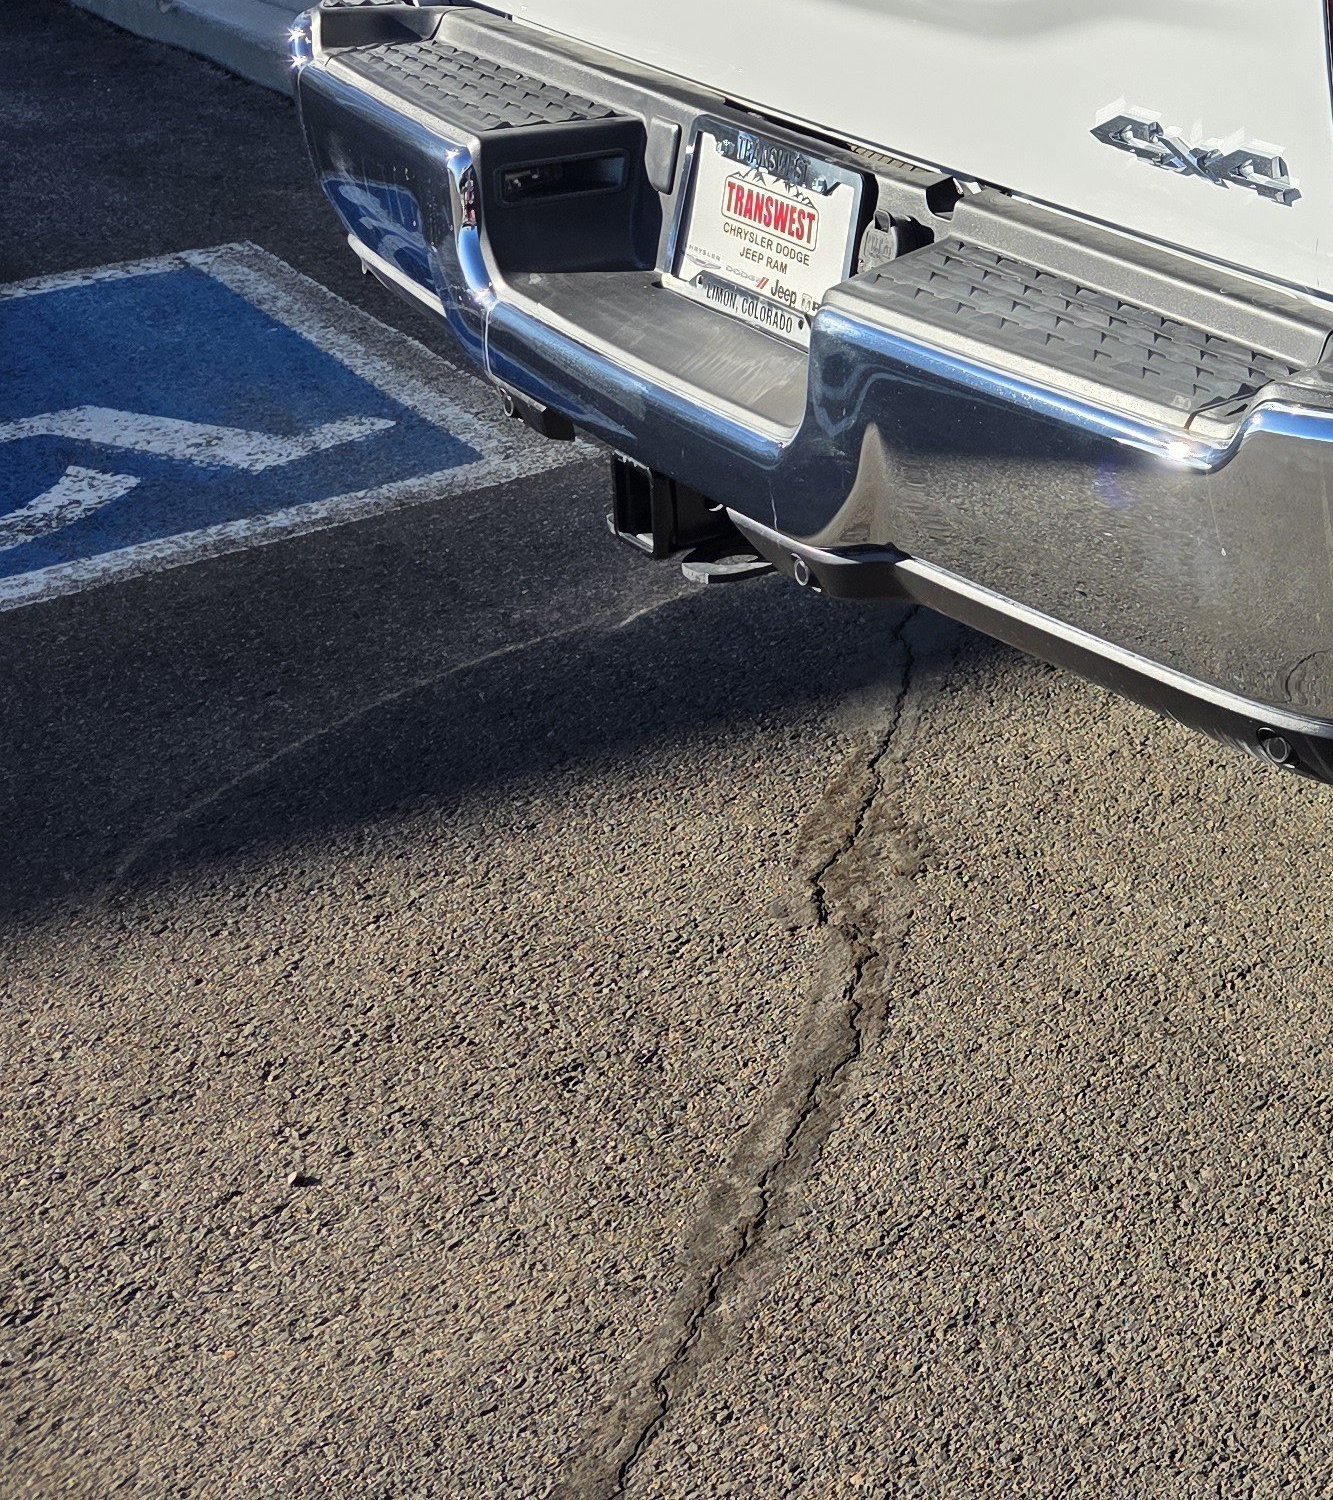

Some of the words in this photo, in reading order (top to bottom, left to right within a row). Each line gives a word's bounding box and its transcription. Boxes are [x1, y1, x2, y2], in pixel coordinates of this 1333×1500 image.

[726, 180, 816, 245] TRANSWEST
[688, 244, 721, 262] HRYSLER
[723, 222, 774, 252] CHRYSLER
[775, 242, 810, 267] DODGE
[739, 246, 764, 264] JEEP
[765, 256, 788, 275] RAM
[706, 282, 739, 315] LIMON,
[741, 296, 793, 334] COLORADO
[770, 279, 797, 308] Jeep
